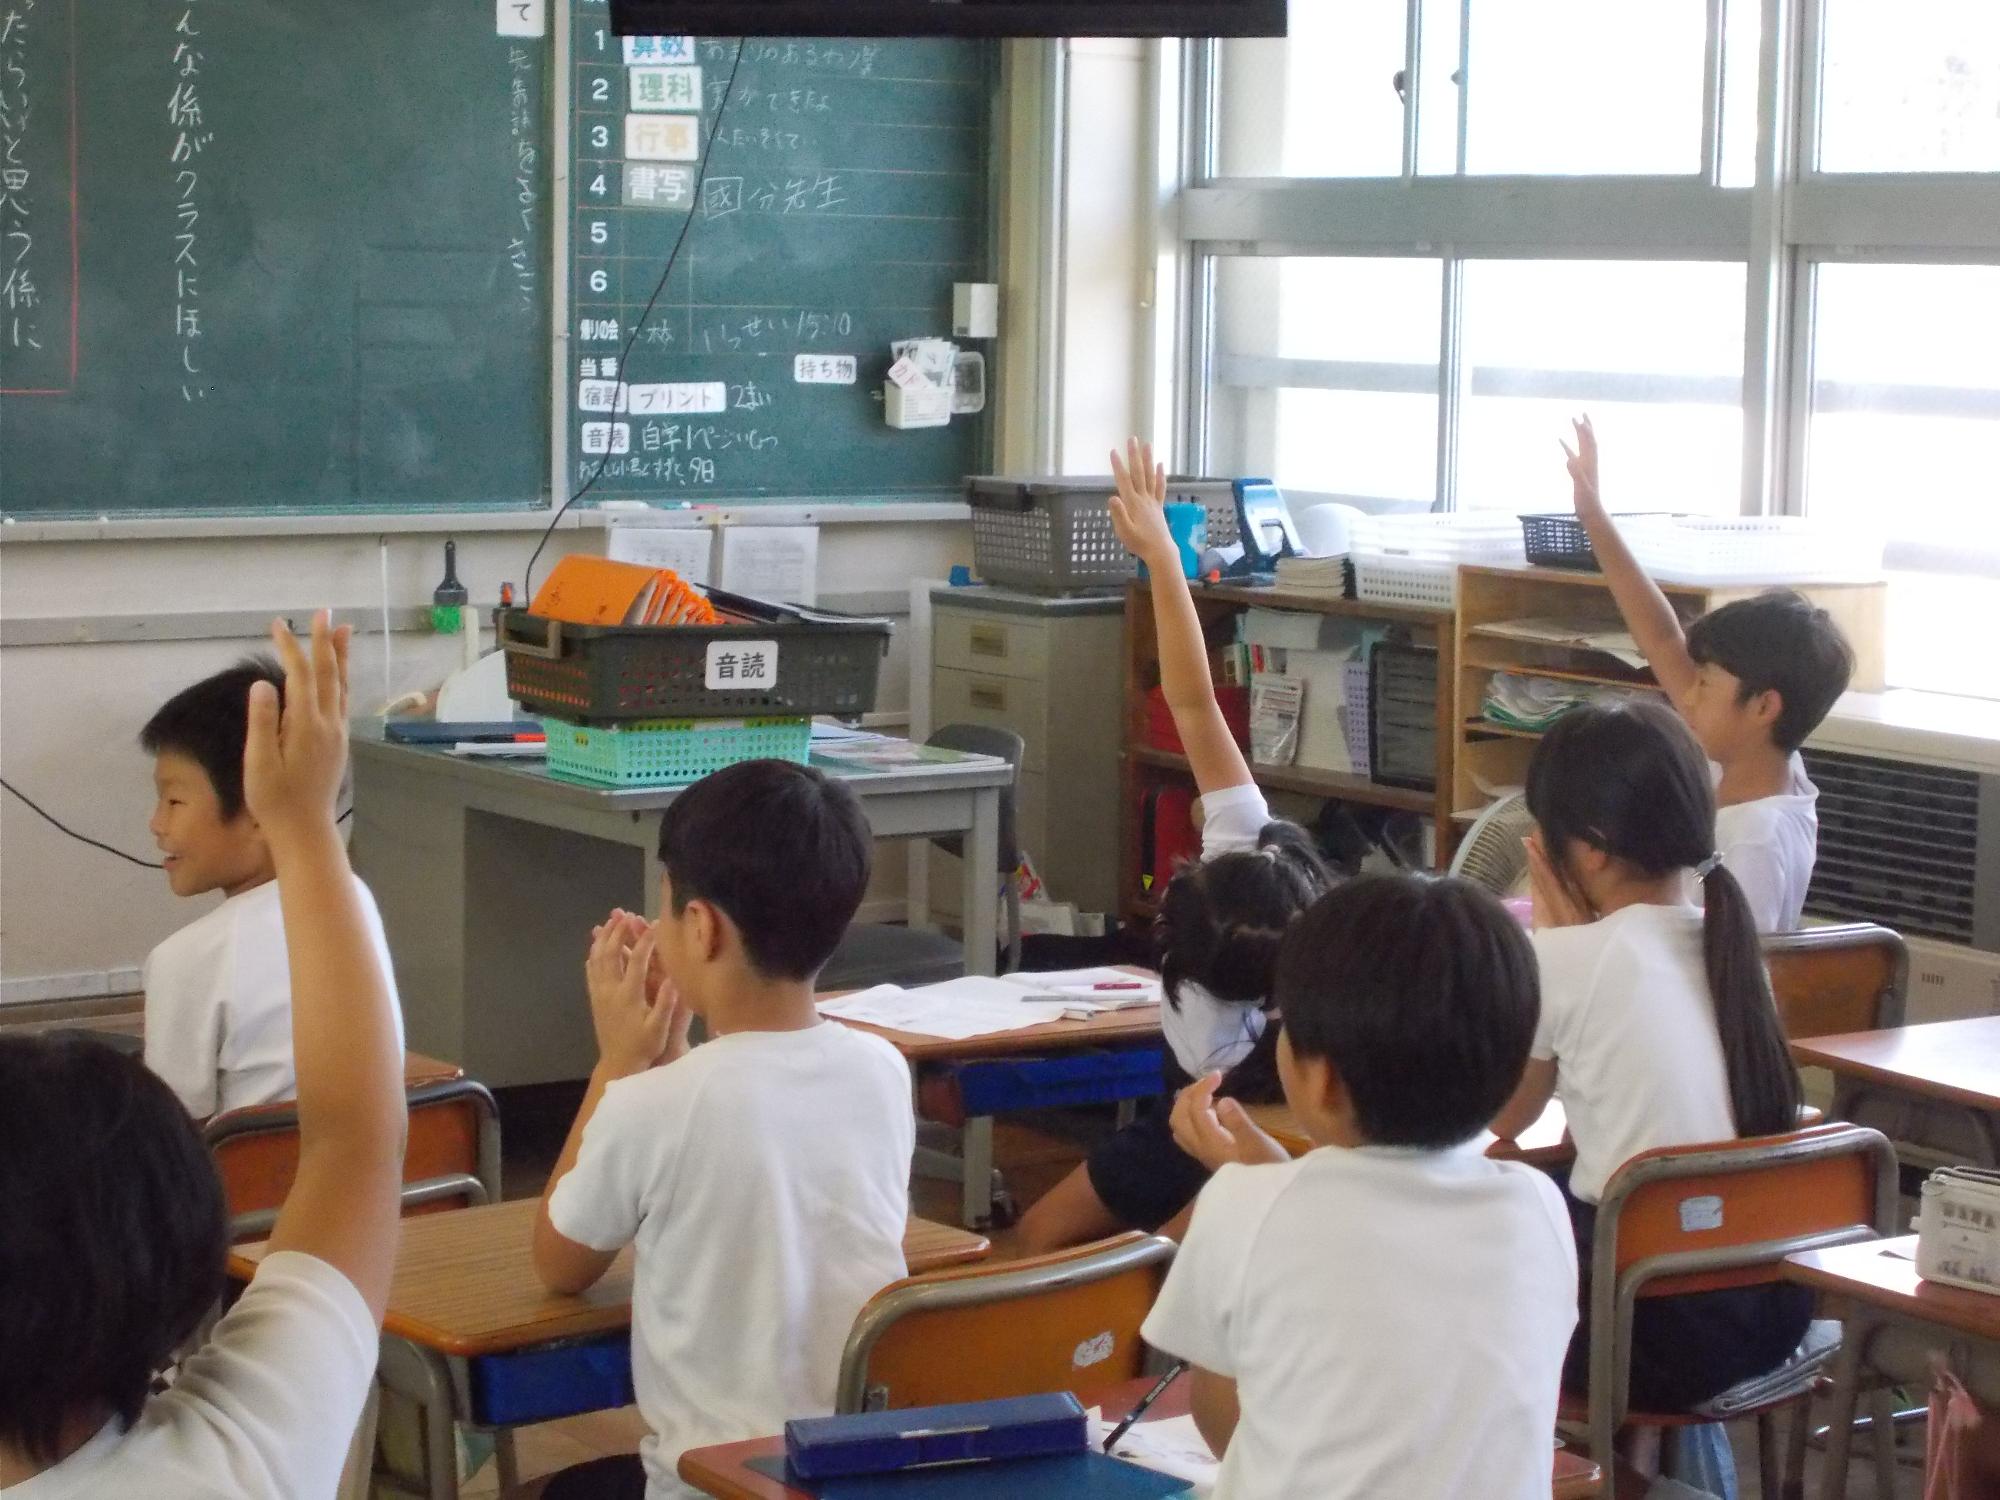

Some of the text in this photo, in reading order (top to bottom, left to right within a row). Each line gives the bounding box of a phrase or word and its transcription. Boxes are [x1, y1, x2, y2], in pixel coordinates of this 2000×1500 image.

[594, 29, 604, 51] 1
[591, 78, 609, 101] 2
[638, 73, 693, 103] 理科
[591, 125, 609, 148] 3
[0, 0, 42, 348] たらいいと思う係に
[589, 174, 608, 196] 4
[629, 166, 688, 202] 書写
[168, 8, 214, 401] んな係がクラスにほしい
[591, 222, 608, 244] 5
[590, 270, 608, 292] 6
[580, 357, 618, 377] 当番
[800, 360, 853, 379] 持ち物
[640, 388, 712, 409] プリント
[587, 427, 625, 449] 音読
[714, 651, 766, 680] 音読
